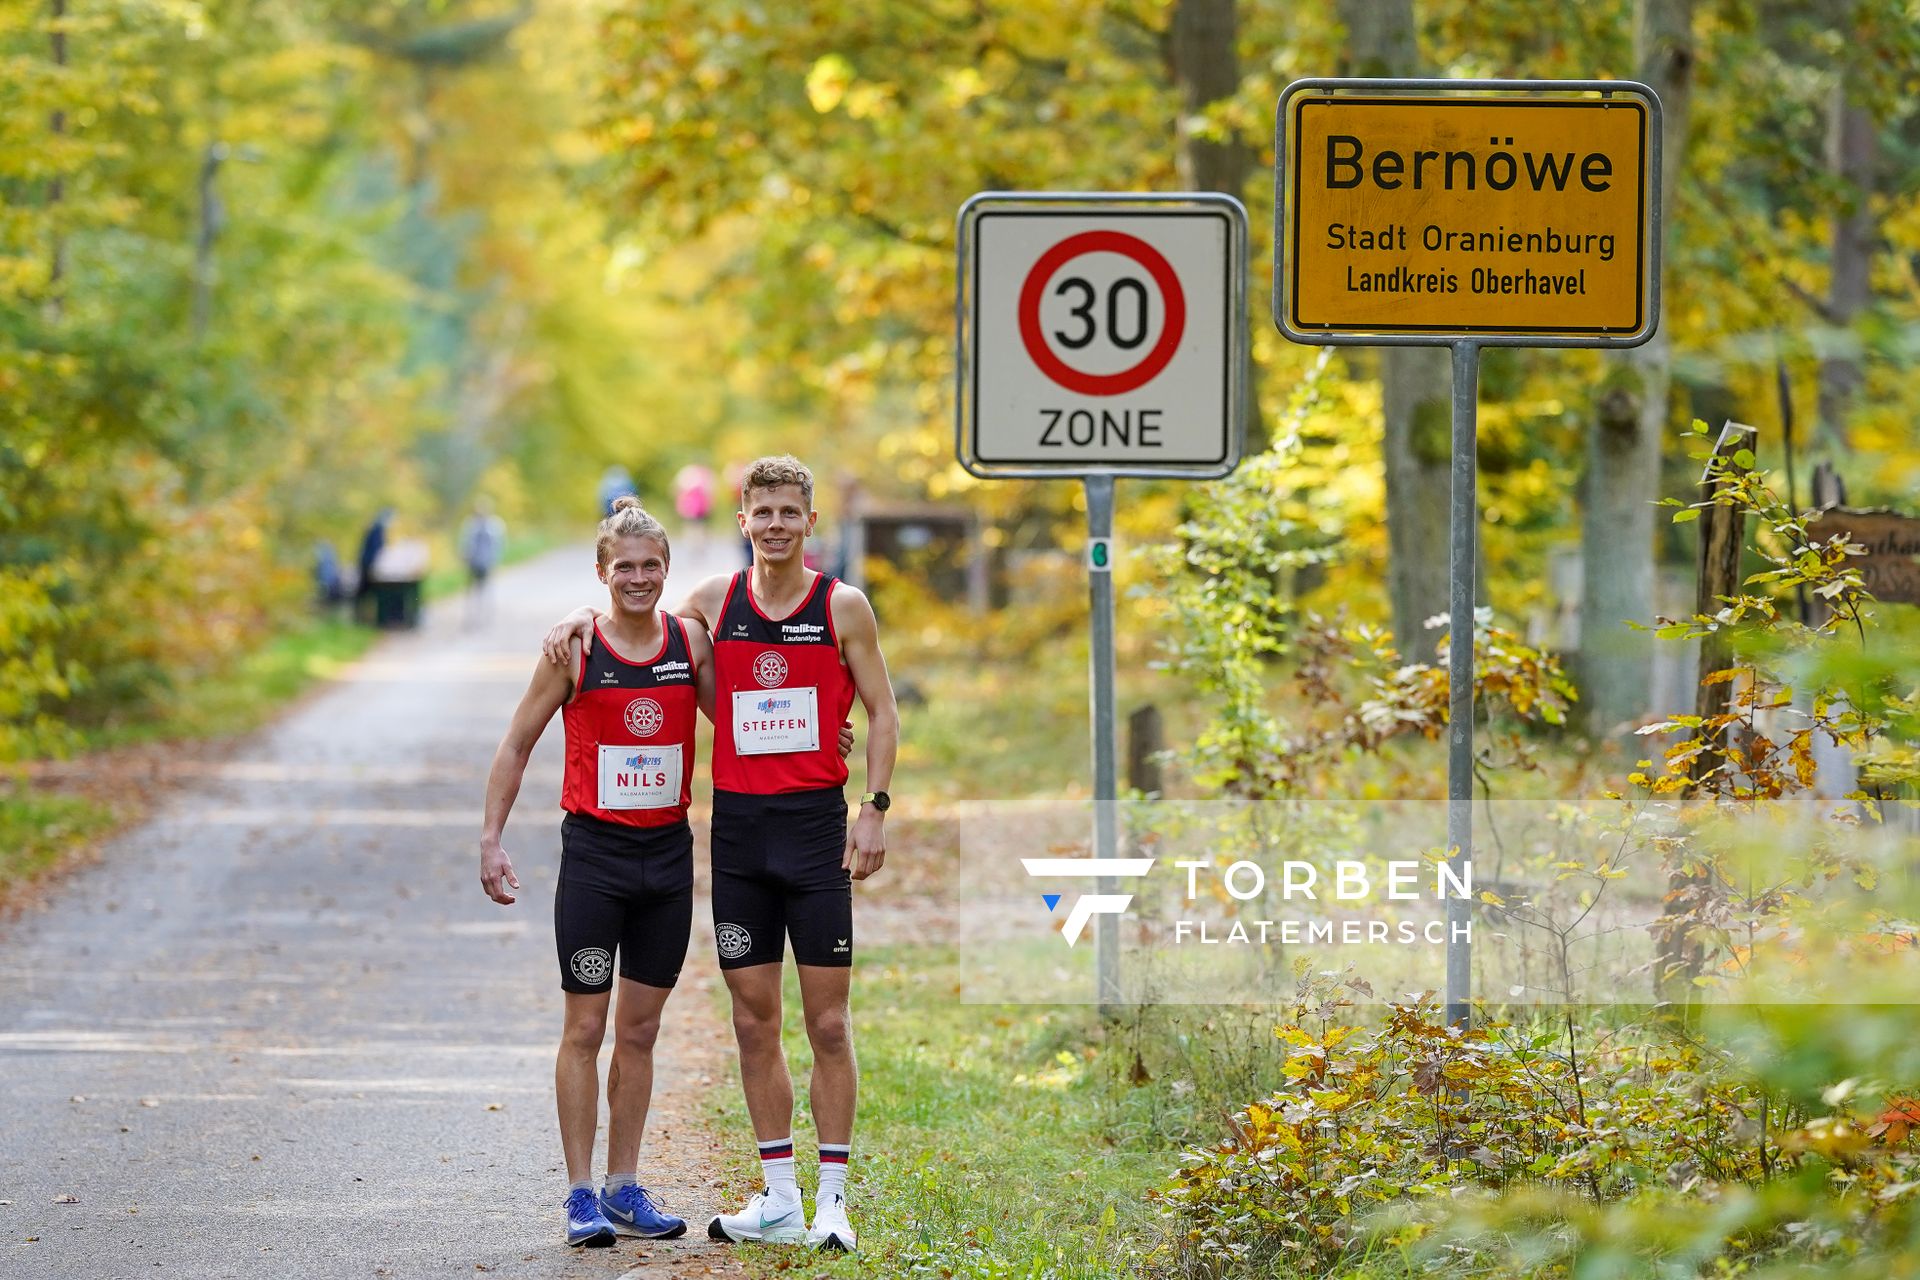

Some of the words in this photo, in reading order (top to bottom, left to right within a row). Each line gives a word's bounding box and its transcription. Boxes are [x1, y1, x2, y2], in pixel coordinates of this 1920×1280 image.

[1326, 134, 1613, 193] Bernöwe
[1326, 222, 1407, 251] Stadt
[1422, 224, 1615, 262] Oranienburg
[1347, 265, 1458, 294] Landkreis
[1471, 267, 1586, 296] Oberhavel
[1054, 276, 1149, 350] 30
[1038, 409, 1163, 448] ZONE
[781, 623, 824, 633] molitor
[783, 634, 822, 642] Laufanalyse
[651, 660, 690, 674] molitor
[656, 671, 690, 682] Laufanalyse
[742, 718, 807, 732] STEFFEN
[616, 771, 667, 788] NILS
